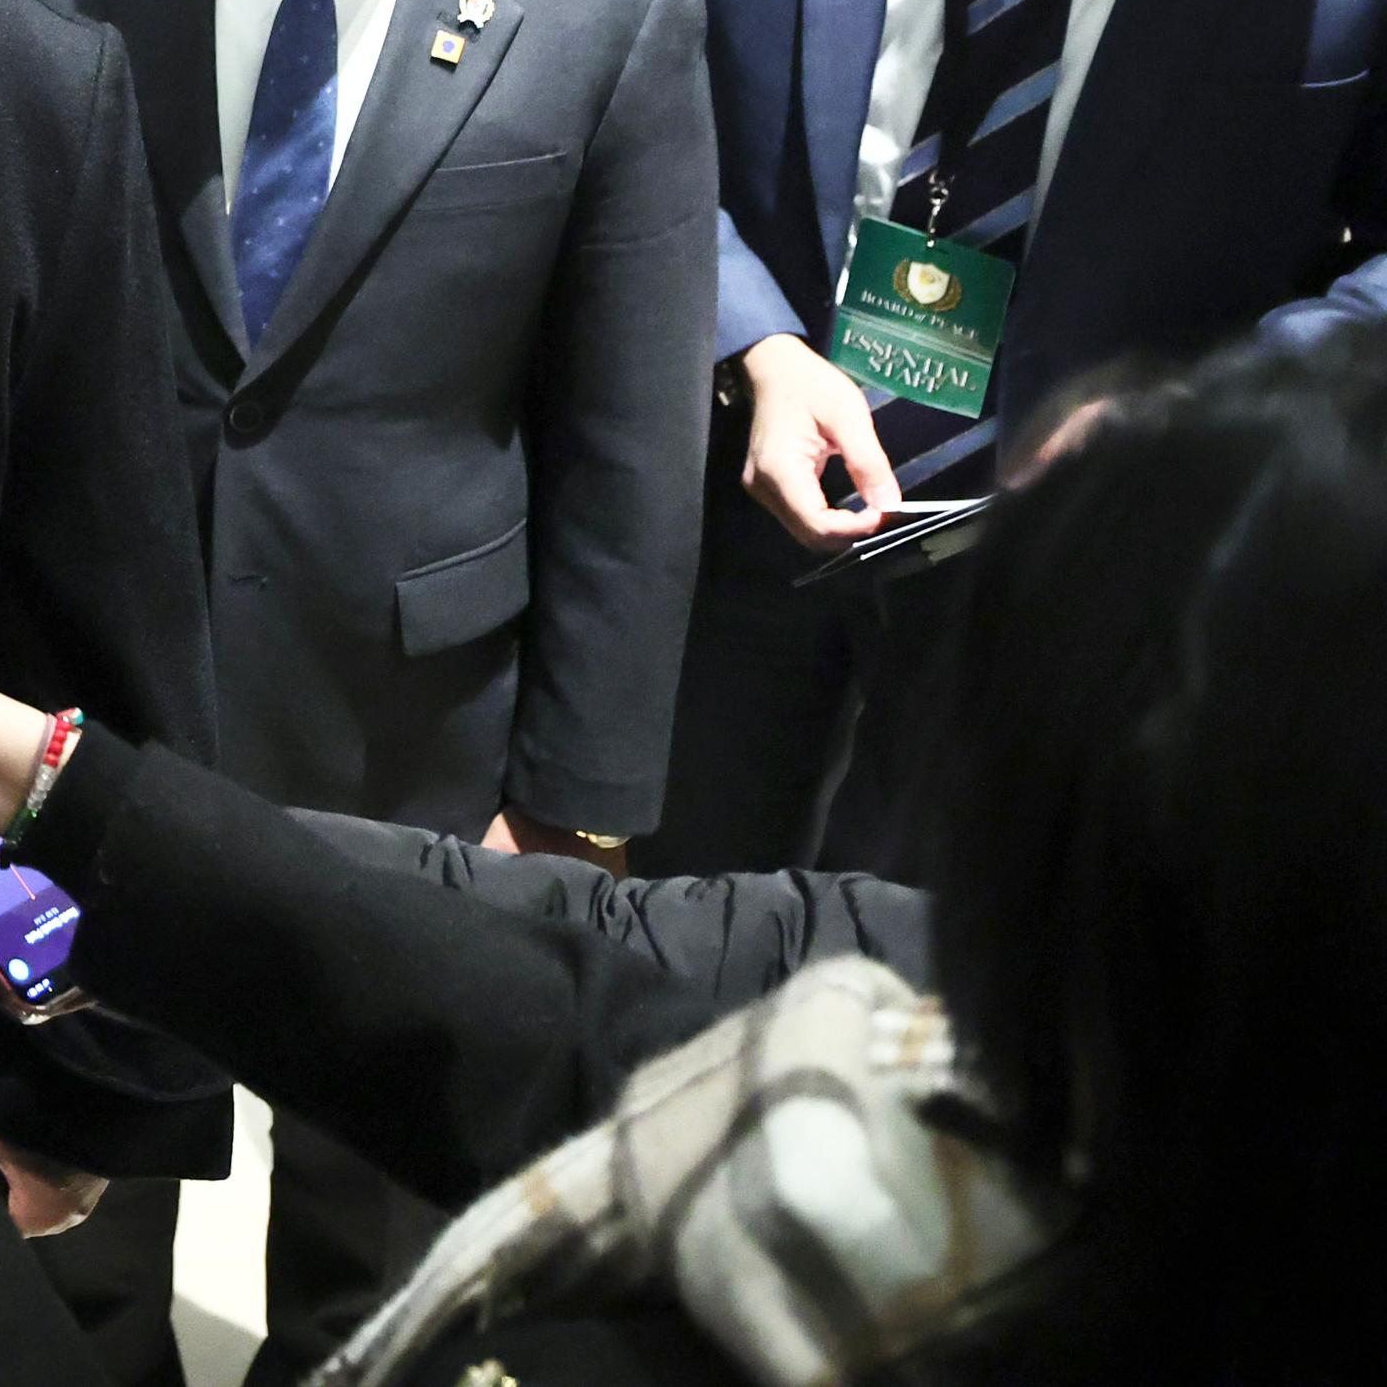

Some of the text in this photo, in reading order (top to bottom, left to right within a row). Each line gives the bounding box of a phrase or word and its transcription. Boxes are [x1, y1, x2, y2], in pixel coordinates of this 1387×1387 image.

[860, 289, 914, 317] BOARD
[842, 328, 977, 392] ESSENTIAL
[868, 356, 944, 394] STAFF
